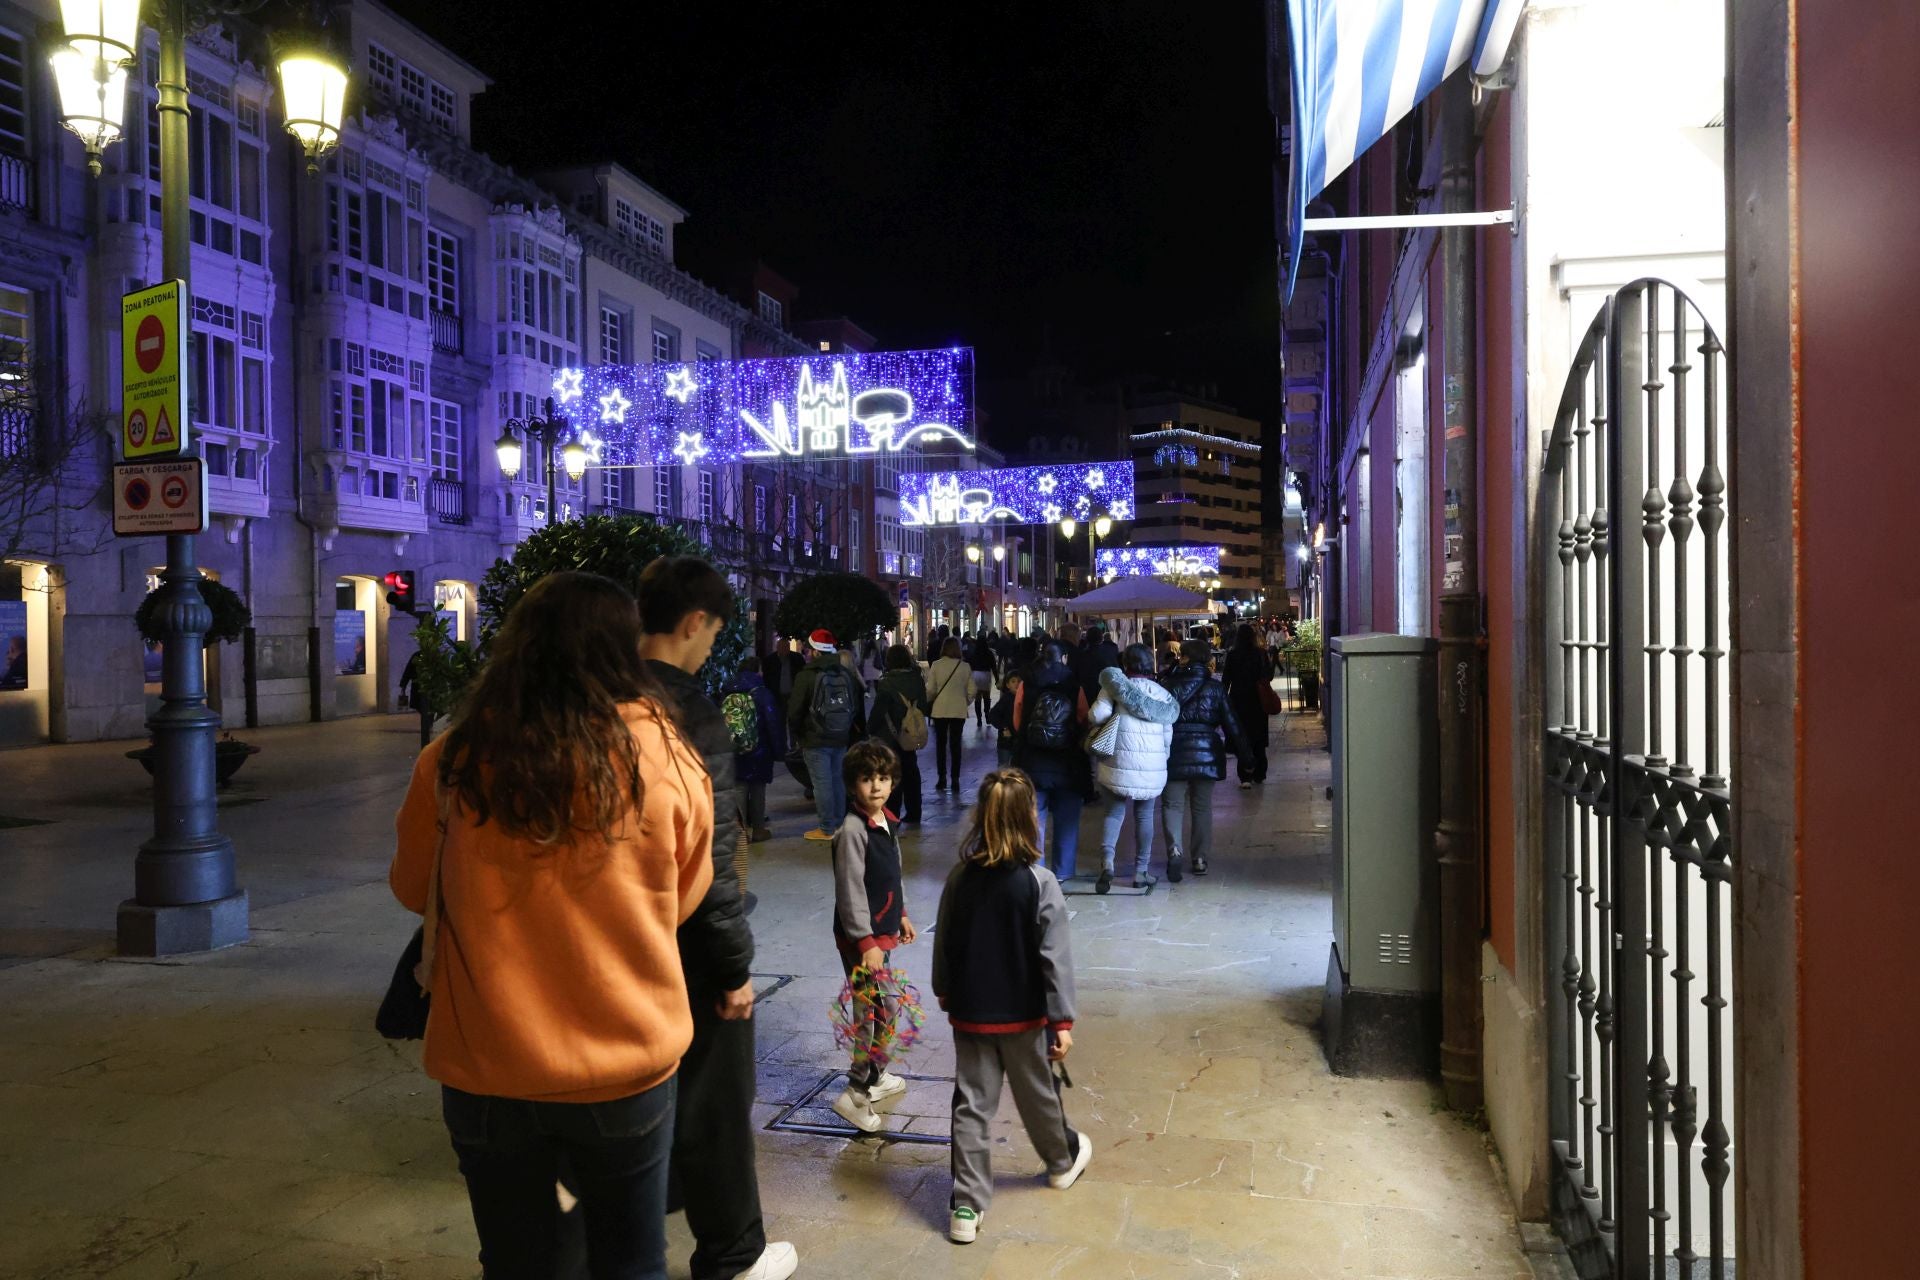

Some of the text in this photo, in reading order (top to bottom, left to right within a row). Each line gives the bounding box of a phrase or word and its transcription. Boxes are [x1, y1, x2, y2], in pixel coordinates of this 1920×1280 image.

[125, 290, 175, 313] ZONA PEATONAL
[131, 422, 143, 435] 20
[119, 467, 144, 475] CARGA
[152, 464, 193, 473] DESCARGA
